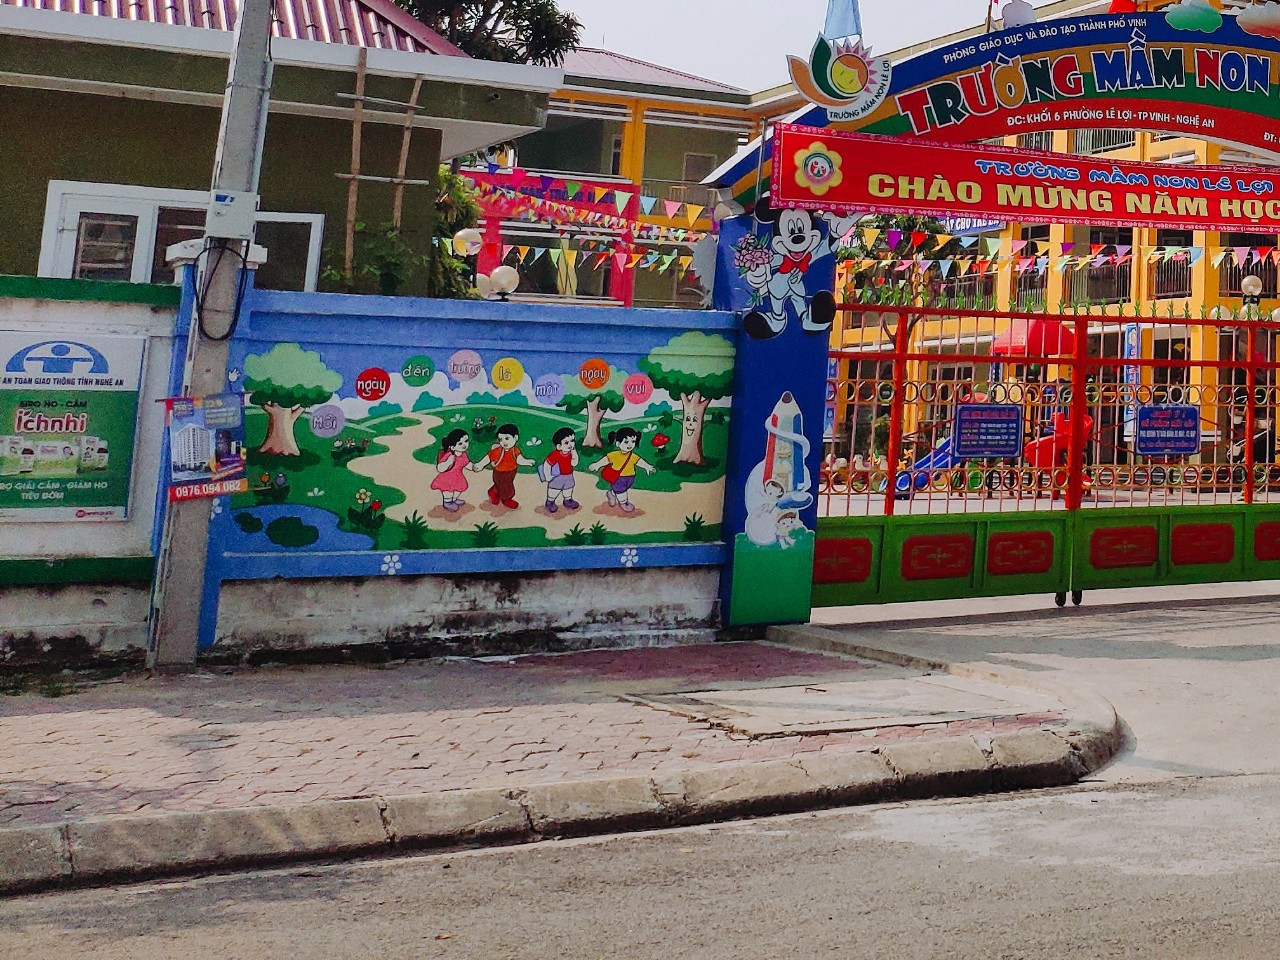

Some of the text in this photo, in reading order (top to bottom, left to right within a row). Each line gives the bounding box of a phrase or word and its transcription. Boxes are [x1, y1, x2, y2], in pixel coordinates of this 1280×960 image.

[943, 15, 1147, 64] PHÒNG GIÁO DỤC VÀ ĐÀO TẠO THÀNH PHỐ VINH
[895, 52, 1084, 136] TRƯỜNG
[1091, 27, 1186, 93] MẦM
[1194, 48, 1271, 97] NON
[1026, 108, 1052, 124] KHỐI
[1054, 112, 1061, 122] 6
[1064, 106, 1104, 121] PHƯỜNG
[1106, 107, 1116, 119] LÊ
[1150, 112, 1170, 122] VINH
[1176, 115, 1200, 129] NGHỆ
[1202, 118, 1215, 128] AN
[1264, 131, 1277, 143] ĐT:
[975, 159, 1274, 194] TRƯỜNG MẦM NON LÊ LỢI
[867, 173, 982, 204] CHÀO
[997, 181, 1113, 212] MỪNG
[1125, 190, 1208, 218] NĂM
[402, 362, 430, 377] đến
[358, 376, 386, 396] ngày
[627, 382, 646, 395] vui
[176, 482, 241, 498] 0976.094.082
